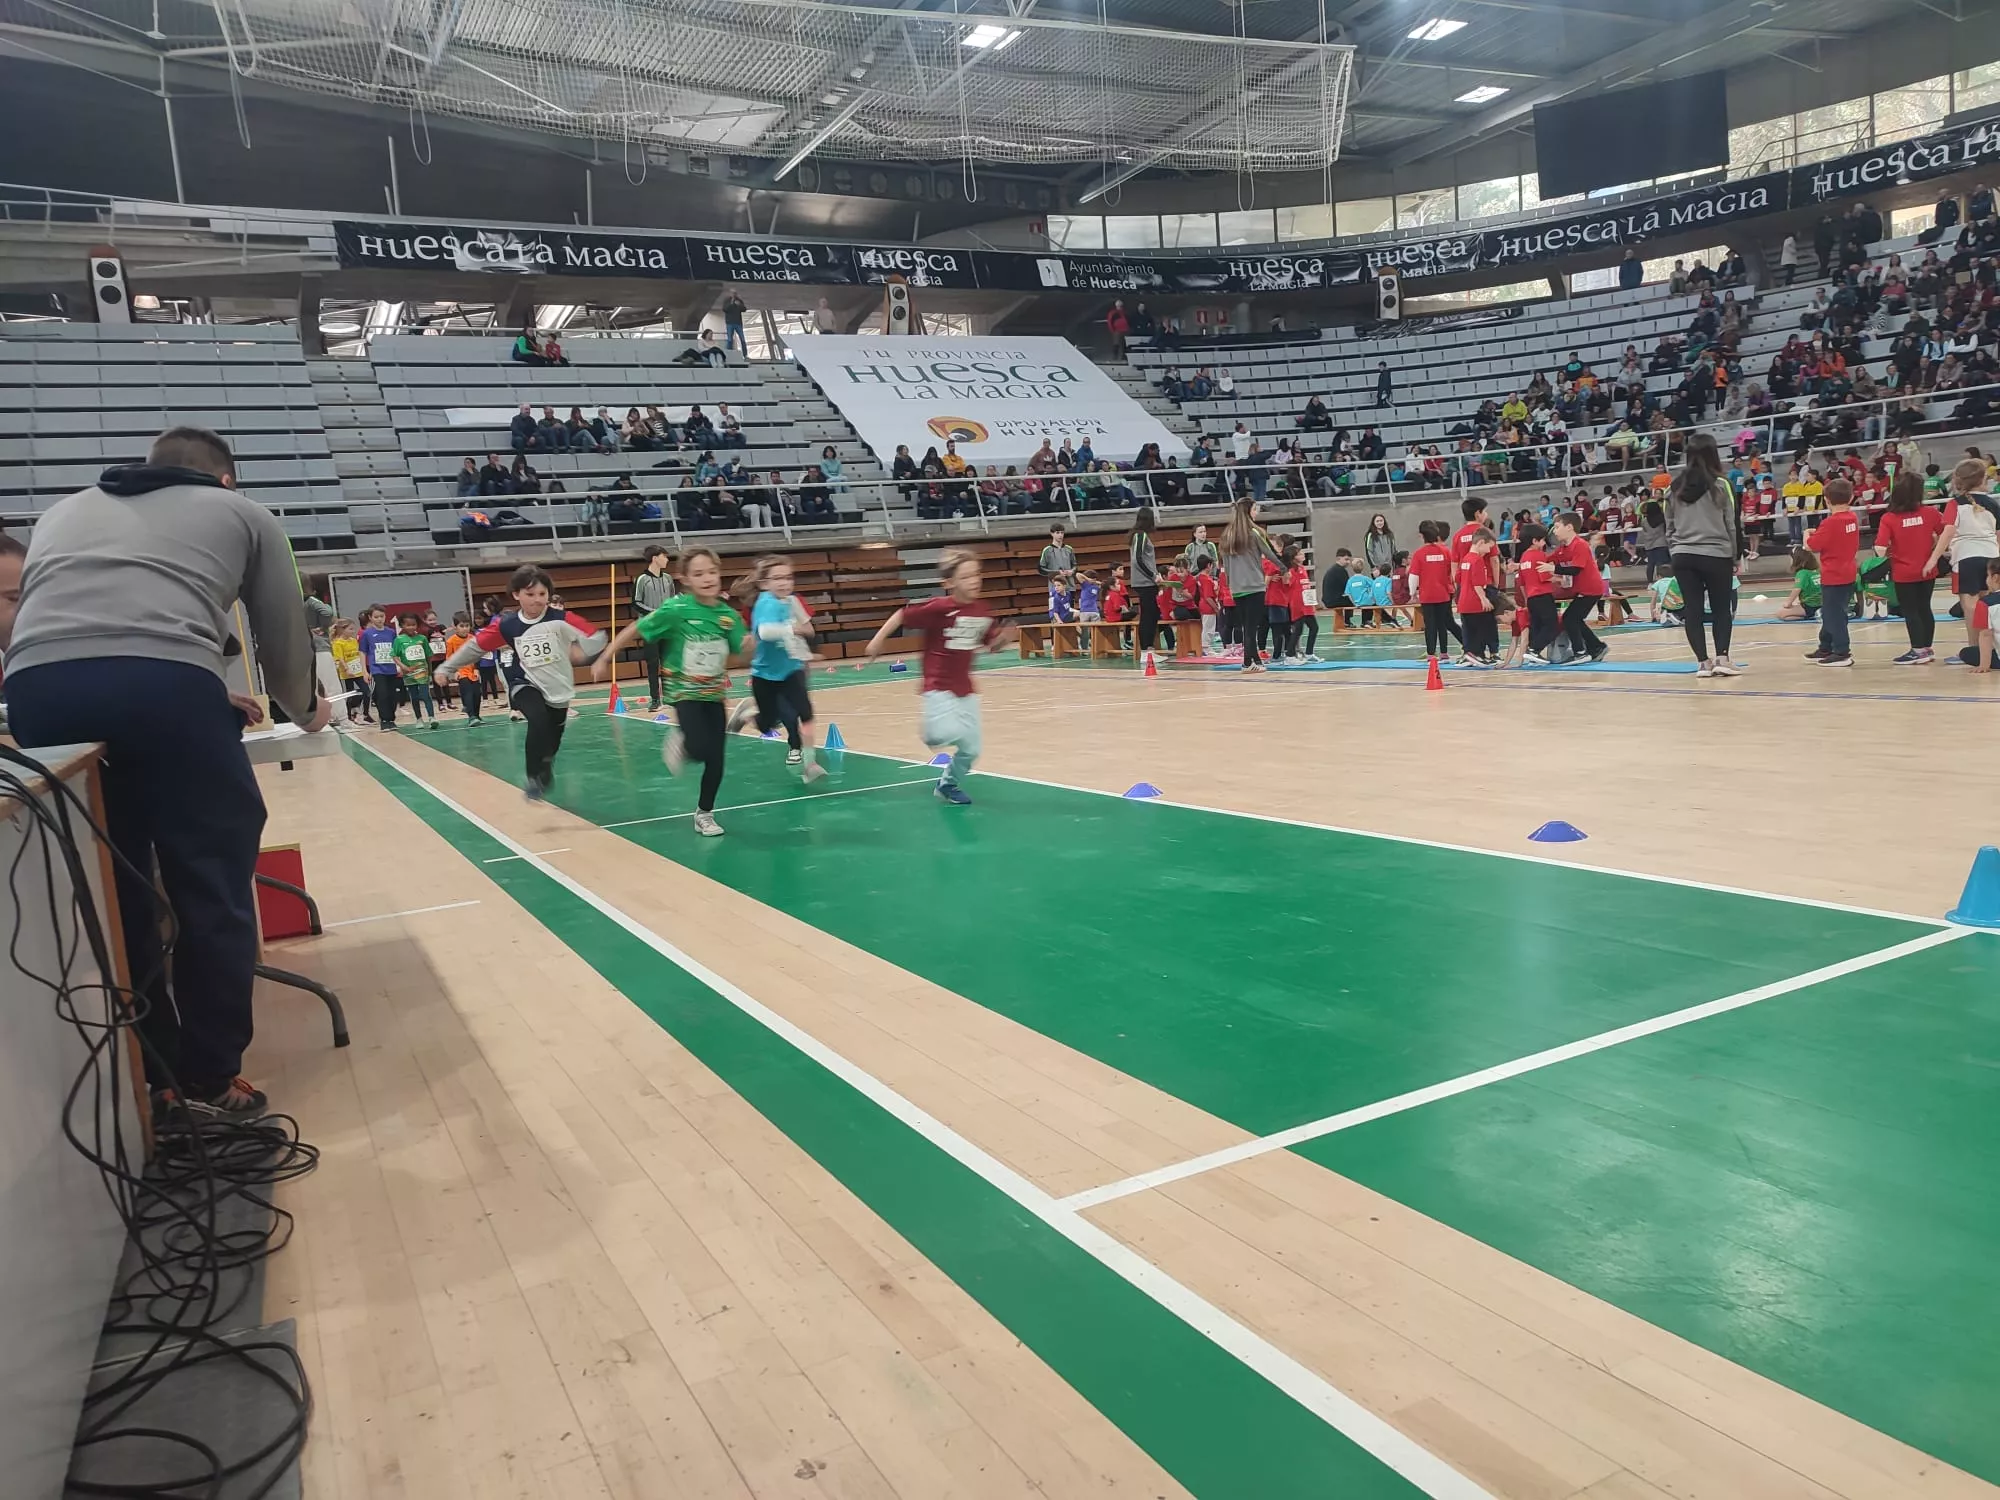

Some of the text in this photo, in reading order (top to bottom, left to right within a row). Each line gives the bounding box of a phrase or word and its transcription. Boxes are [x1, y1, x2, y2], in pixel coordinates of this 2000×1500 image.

[1069, 260, 1155, 276] Ayuntamiento
[1072, 276, 1138, 290] de Huesca
[1000, 427, 1109, 437] HUESCA
[522, 642, 552, 658] 238
